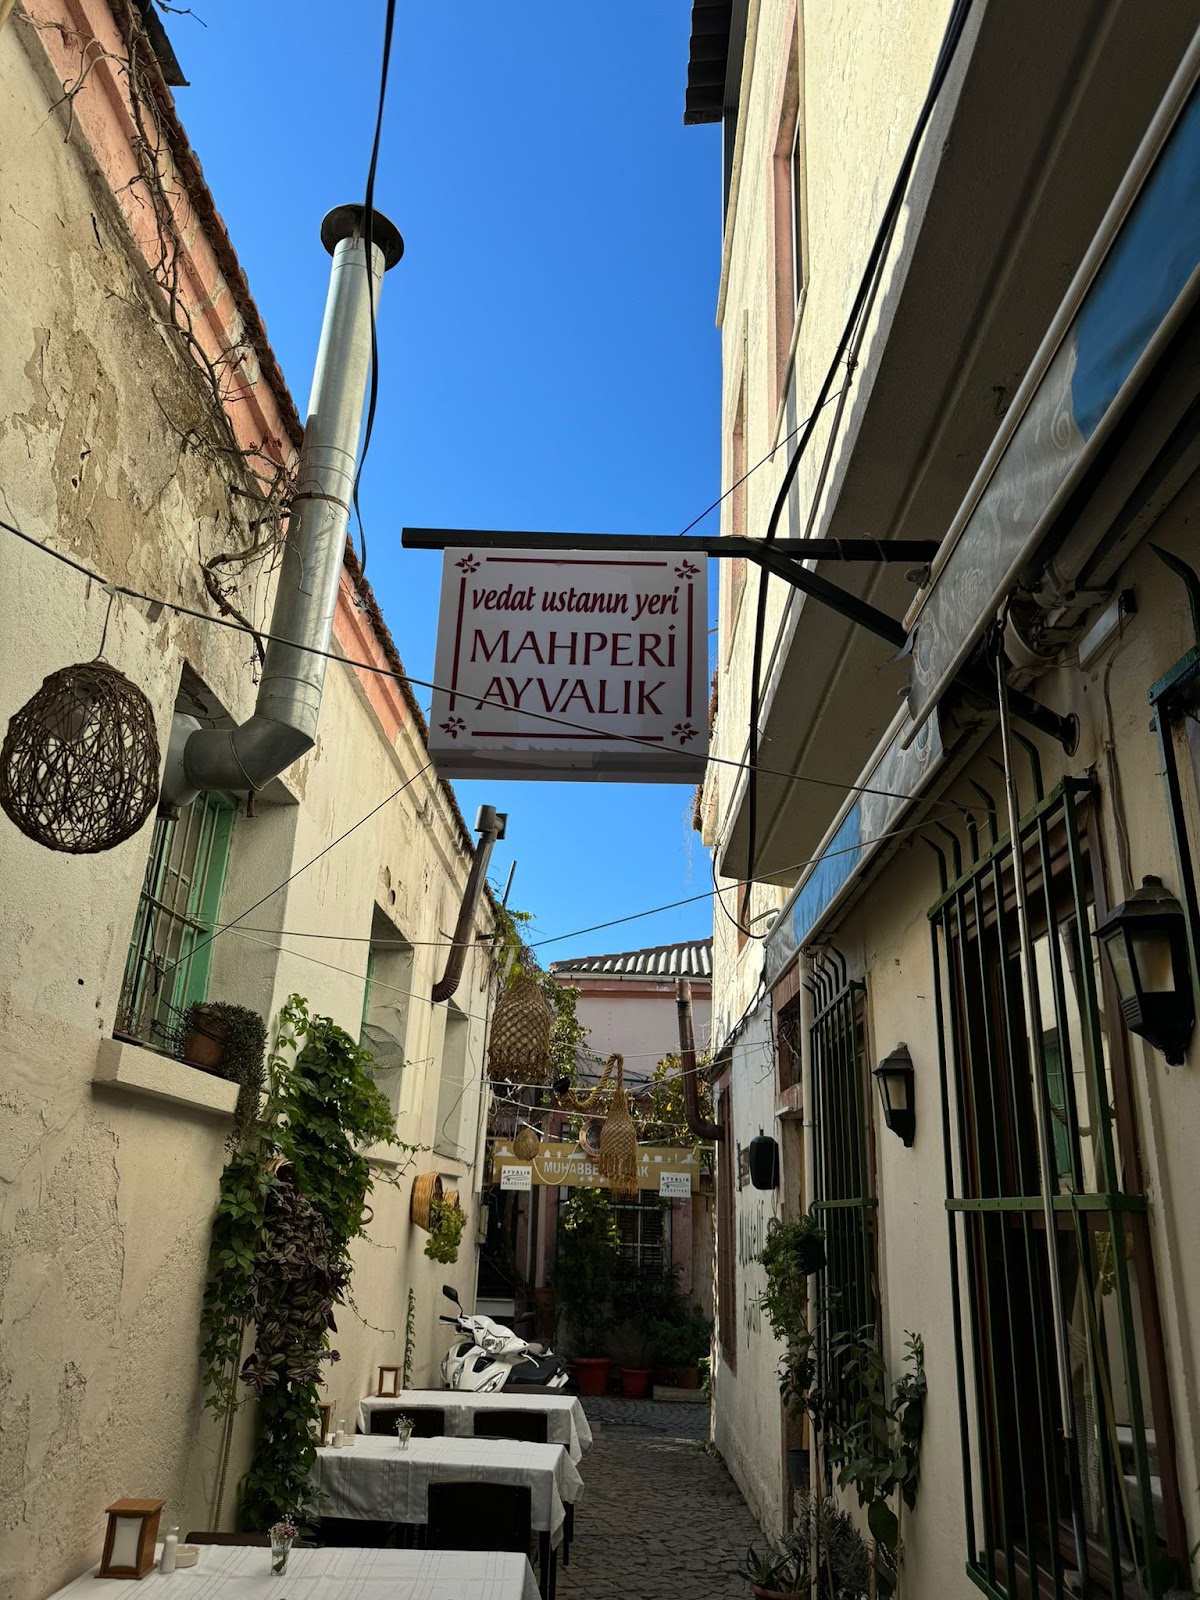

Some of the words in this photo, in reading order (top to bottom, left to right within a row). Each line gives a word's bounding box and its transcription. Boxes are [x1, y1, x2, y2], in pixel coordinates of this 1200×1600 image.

[472, 584, 536, 613] vedat
[541, 587, 629, 615] ustanın
[631, 585, 680, 621] yeri
[470, 624, 677, 668] MAHPERİ
[475, 676, 668, 715] AYVALIK
[543, 1161, 599, 1176] MUHABBE
